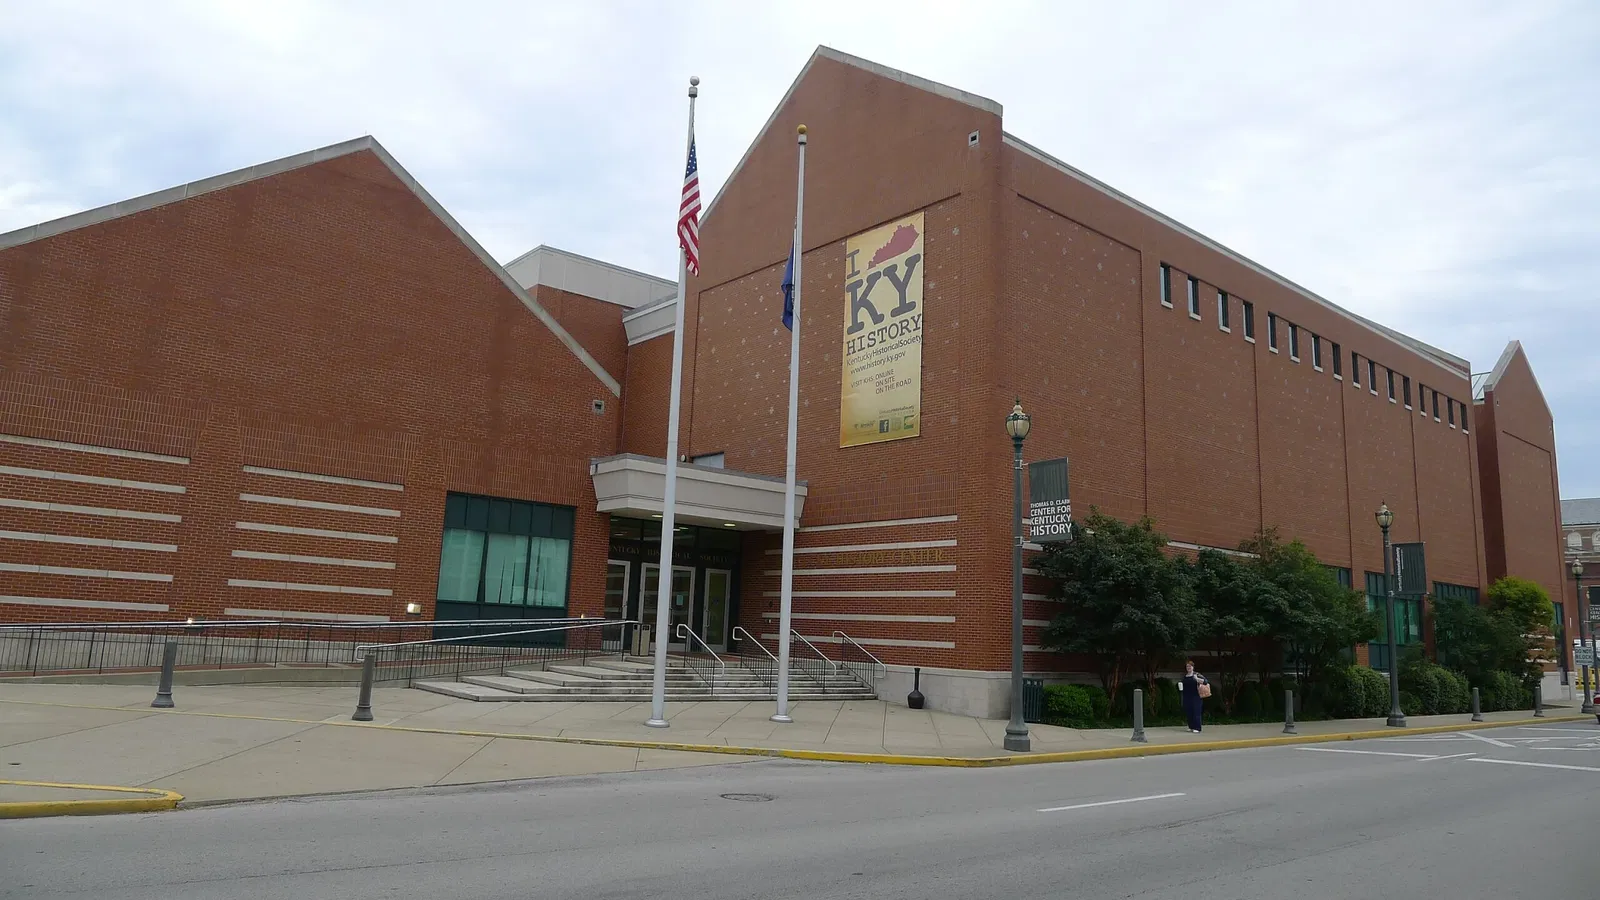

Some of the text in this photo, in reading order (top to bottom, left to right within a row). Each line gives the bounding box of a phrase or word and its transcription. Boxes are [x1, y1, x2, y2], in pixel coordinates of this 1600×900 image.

[846, 248, 860, 280] I
[846, 253, 921, 335] KY
[846, 313, 922, 356] HISTORY
[850, 379, 862, 388] VISIT
[875, 368, 894, 380] ONLINE
[875, 376, 895, 388] ON SITE
[875, 378, 912, 395] ON THE ROAD
[1030, 505, 1071, 517] CENTER FOR
[1030, 513, 1071, 525] KENTUCKY
[1030, 523, 1072, 536] HISTORY
[836, 551, 885, 565] HISTORY
[889, 548, 945, 564] CENTER
